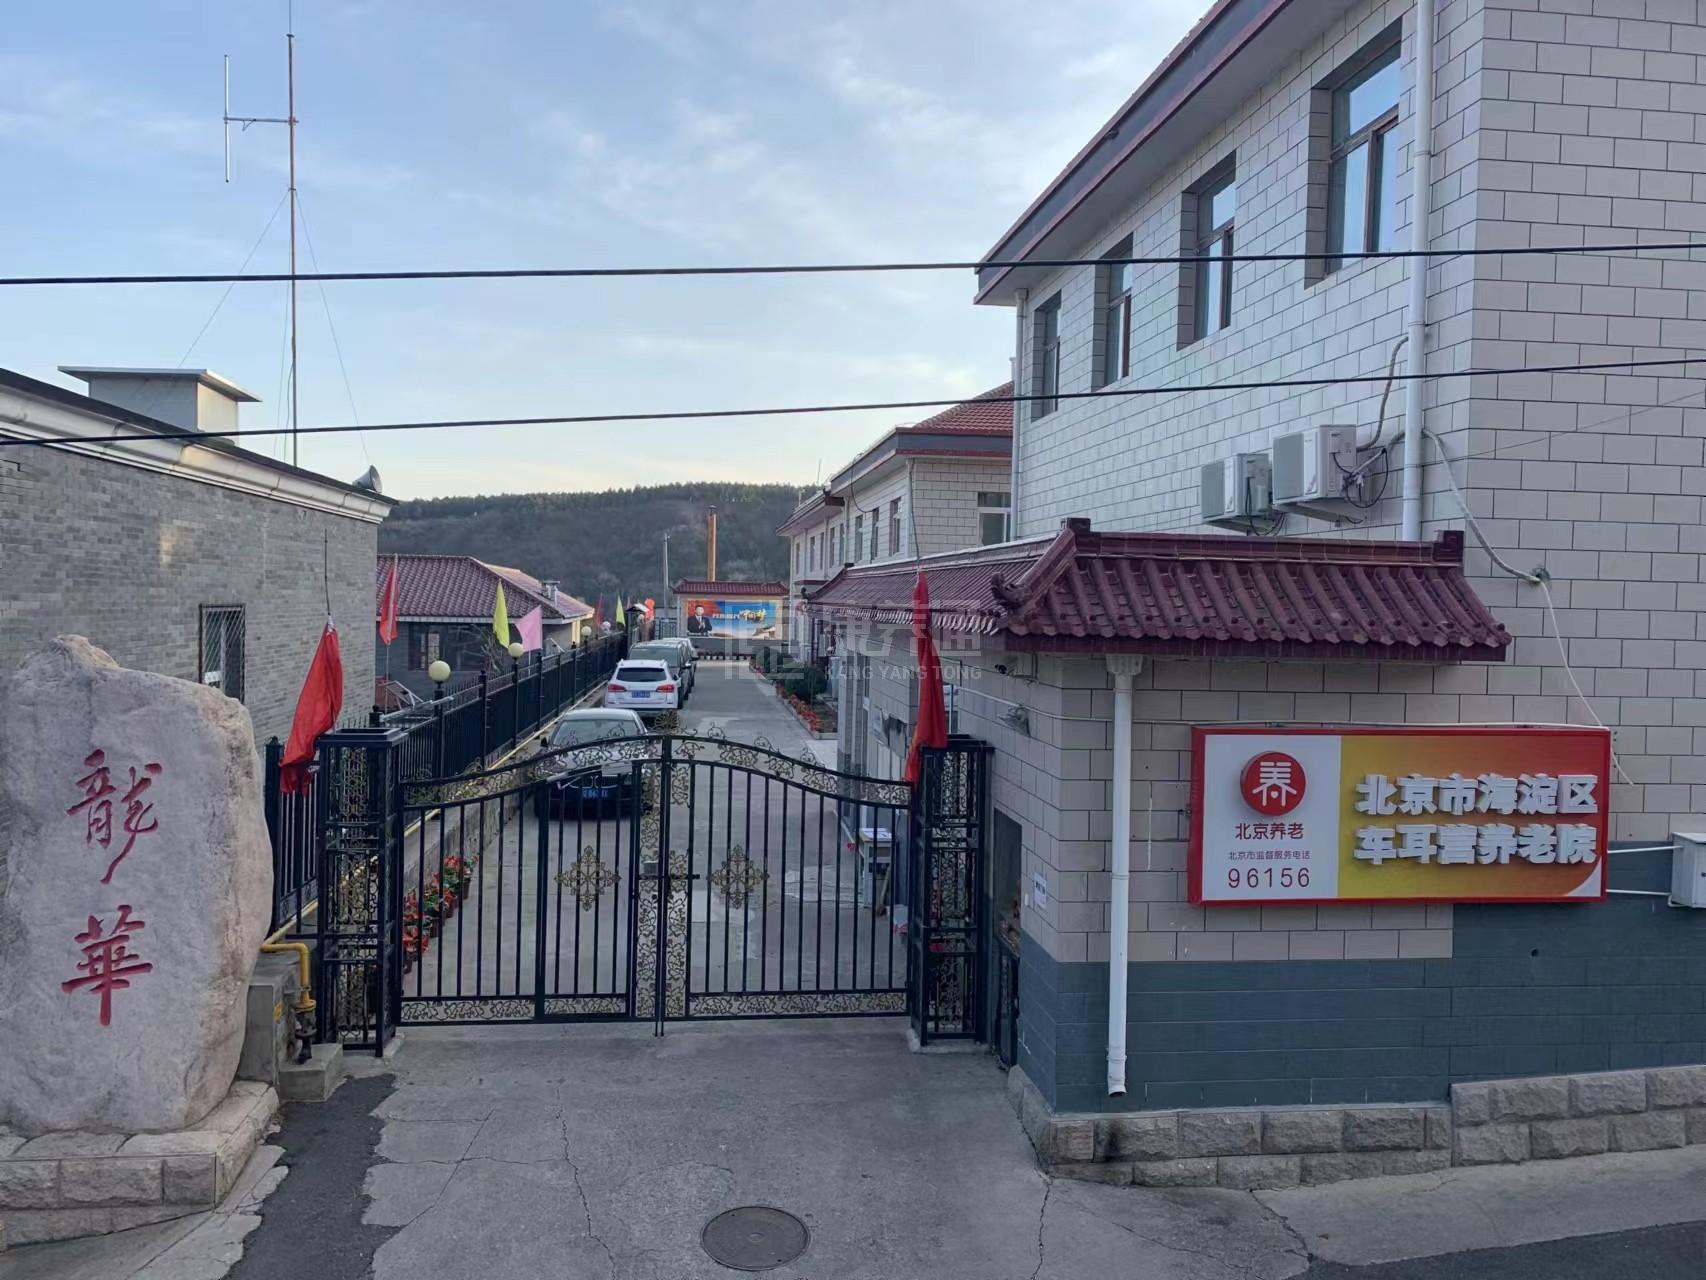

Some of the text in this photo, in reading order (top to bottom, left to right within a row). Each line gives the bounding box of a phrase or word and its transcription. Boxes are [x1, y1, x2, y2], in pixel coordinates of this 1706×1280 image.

[1354, 773, 1599, 815] 北京市海淀区
[1235, 823, 1304, 840] 北京养老
[1354, 824, 1598, 865] 车耳营养老院
[1228, 850, 1311, 860] 北京市监督服务电话
[1228, 868, 1310, 888] 96156
